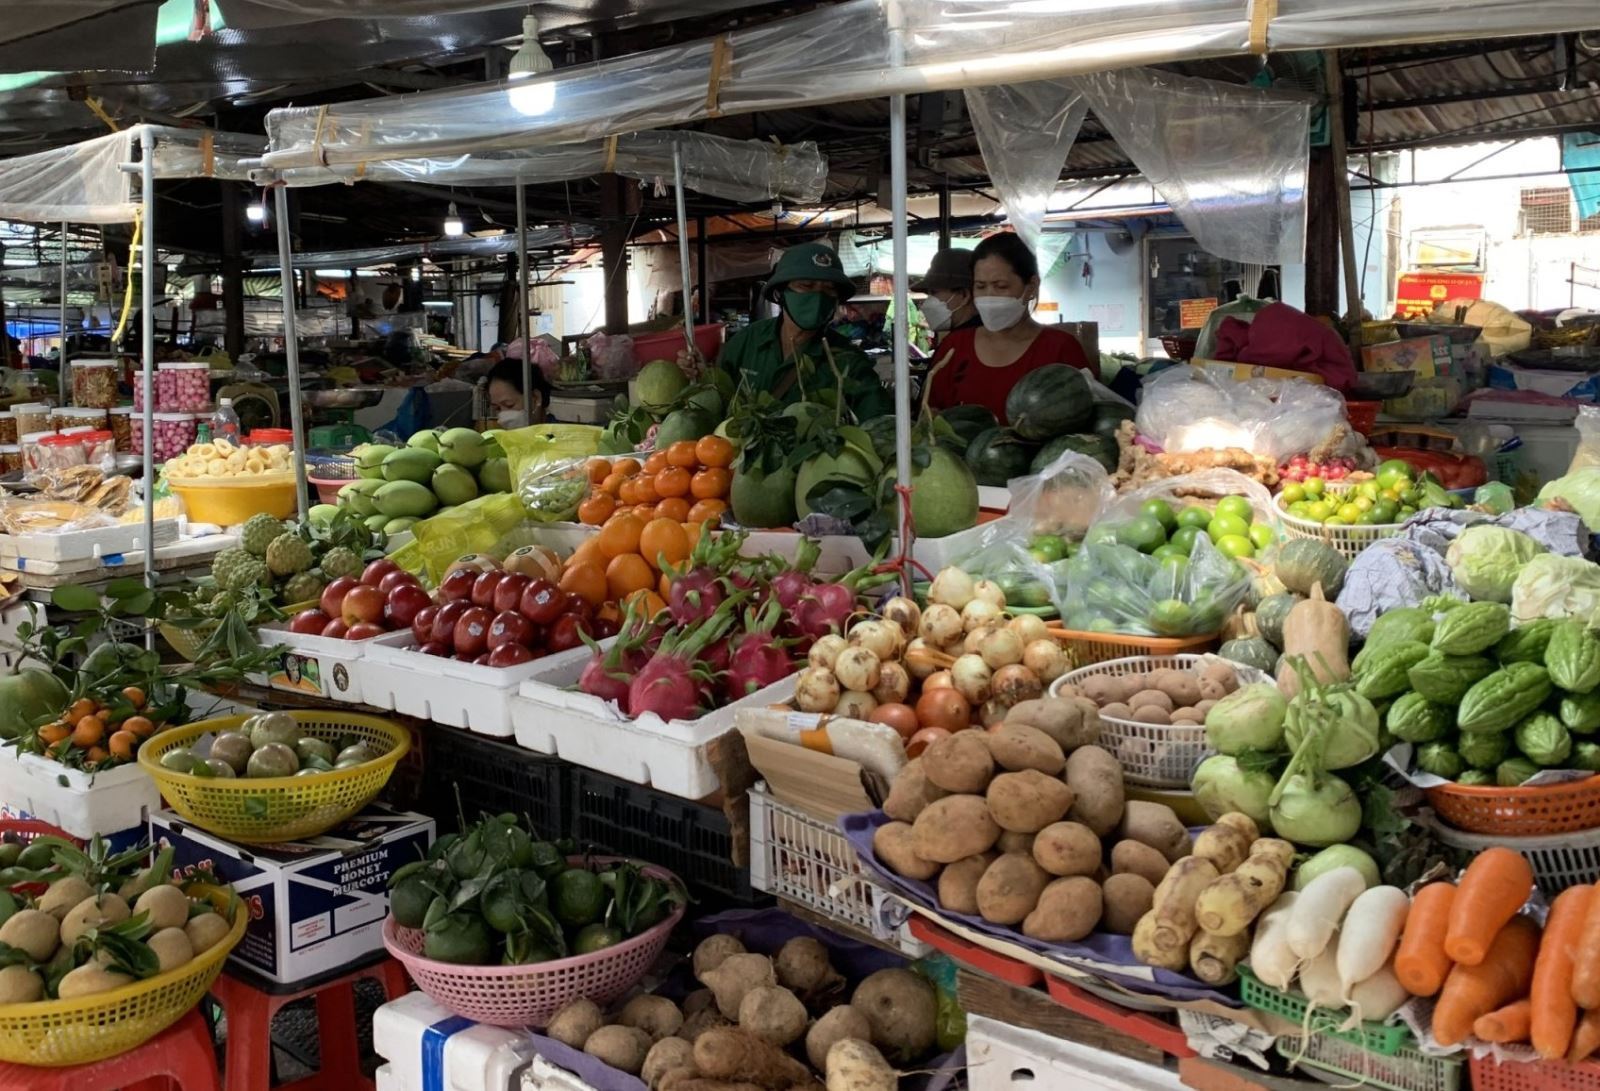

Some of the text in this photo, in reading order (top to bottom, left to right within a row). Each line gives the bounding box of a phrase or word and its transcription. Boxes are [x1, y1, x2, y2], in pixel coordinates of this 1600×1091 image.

[333, 849, 389, 875] PREMIUM
[341, 862, 382, 884] HONEY
[333, 870, 390, 897] MURCOTT
